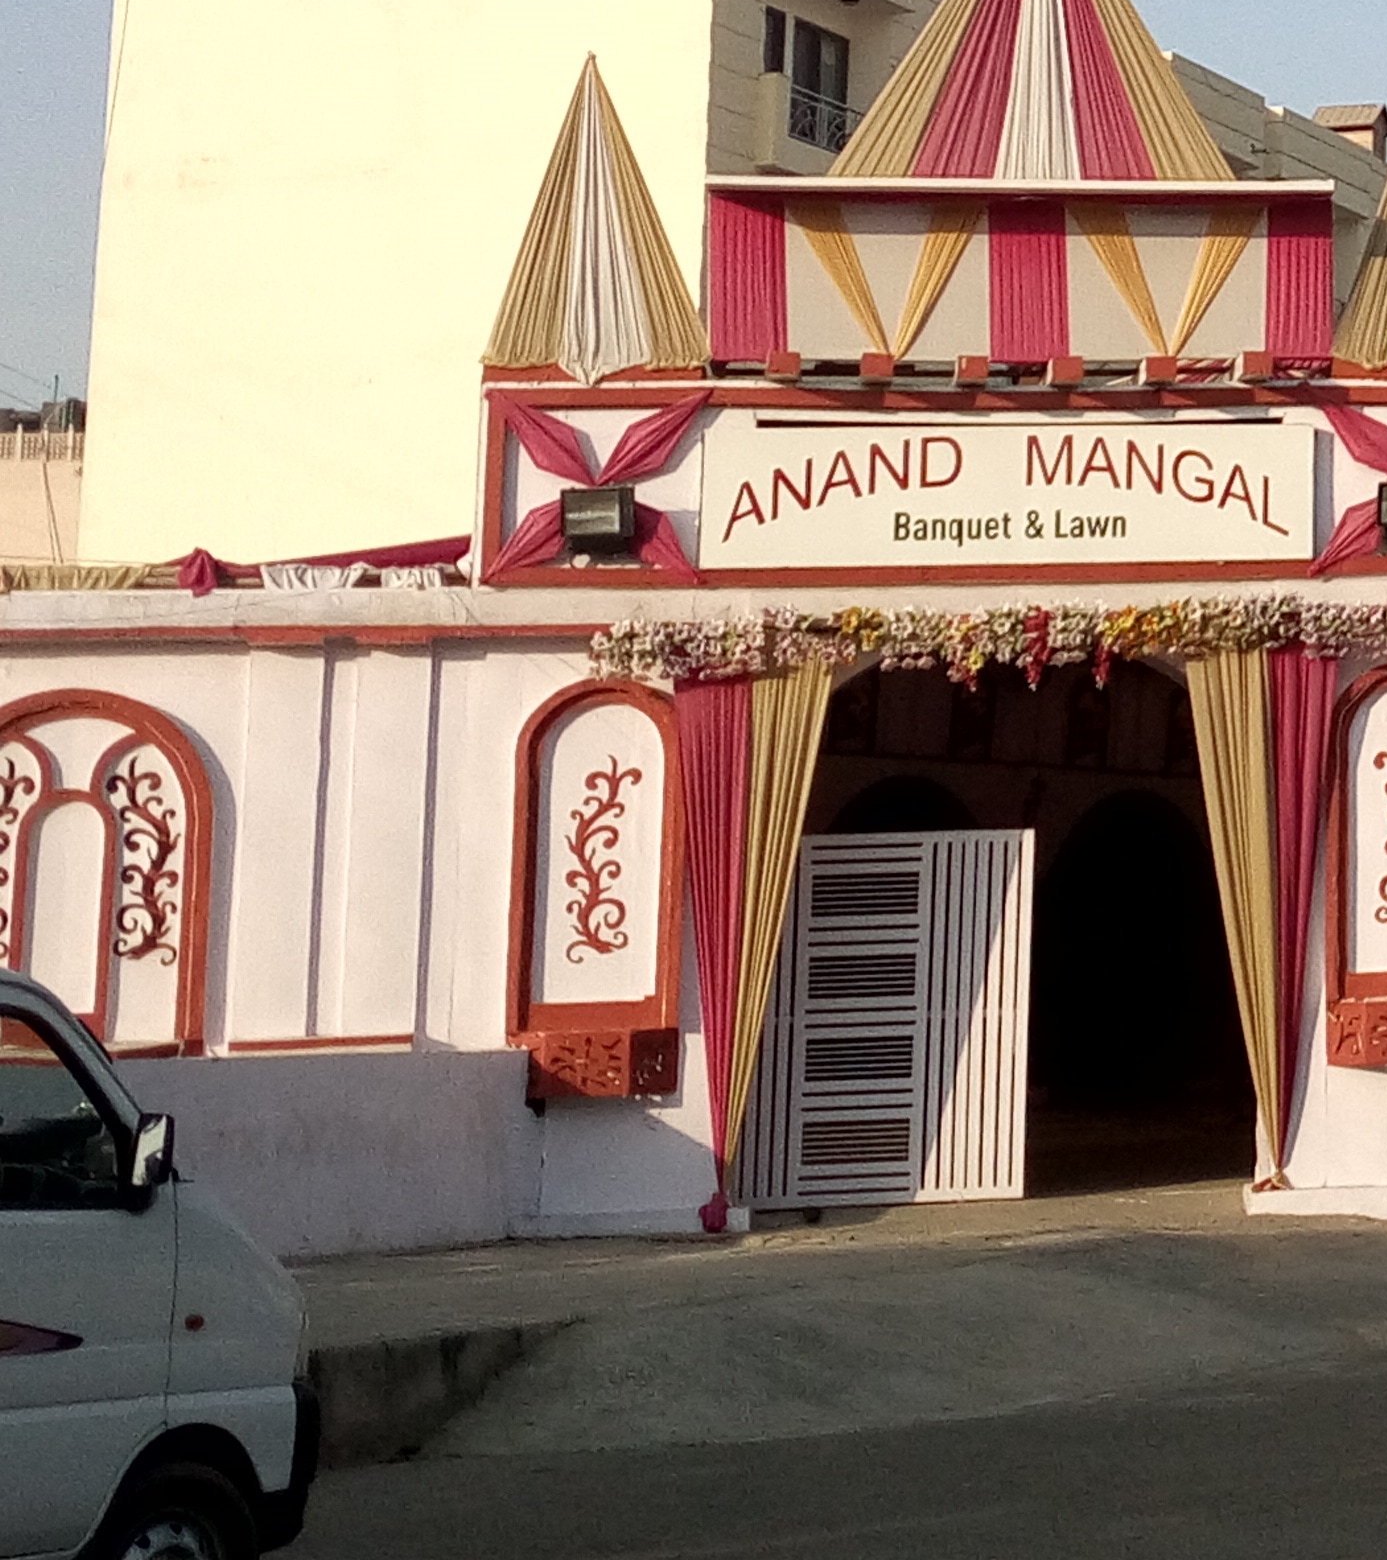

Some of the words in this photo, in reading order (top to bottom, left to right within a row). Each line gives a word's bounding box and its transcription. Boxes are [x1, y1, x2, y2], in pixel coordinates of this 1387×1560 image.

[722, 436, 963, 543] ANAND
[1024, 434, 1289, 537] MANGAL
[893, 512, 1012, 546] Banquet
[1025, 513, 1045, 539] &
[1054, 510, 1127, 539] Lawn
